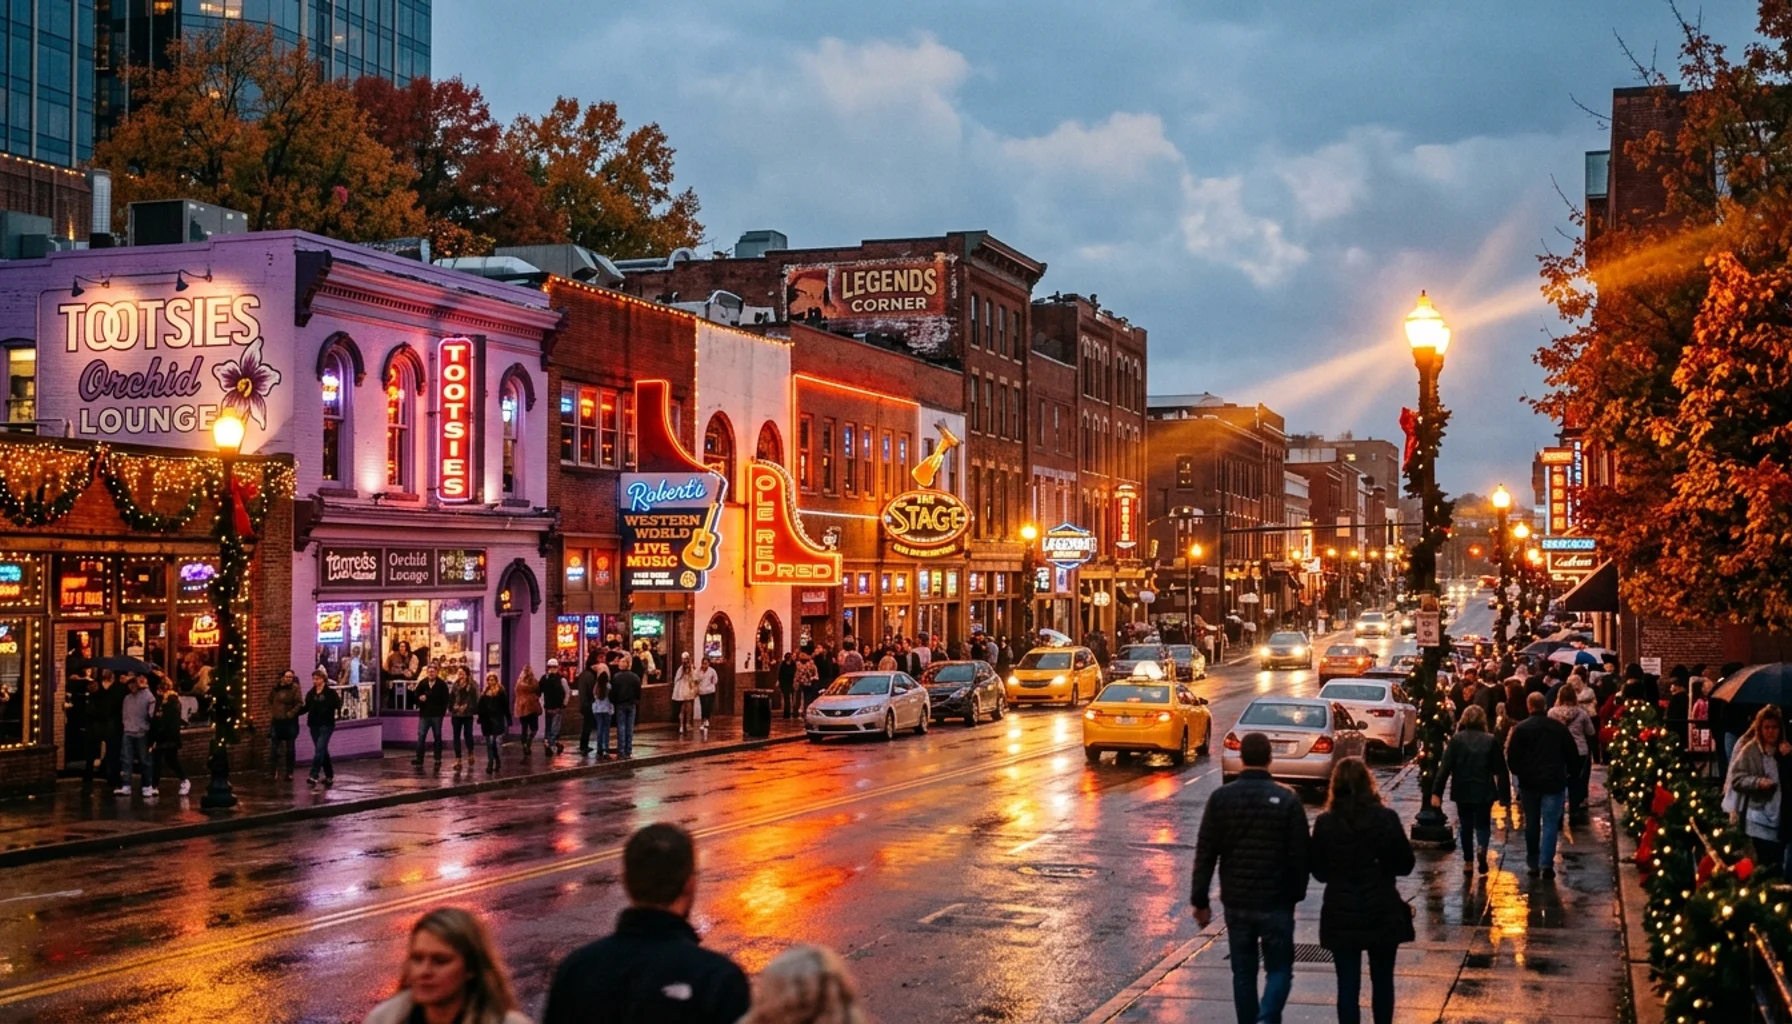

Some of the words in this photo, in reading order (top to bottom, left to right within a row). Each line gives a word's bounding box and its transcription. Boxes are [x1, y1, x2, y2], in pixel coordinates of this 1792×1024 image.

[842, 268, 937, 299] LEGENDS
[851, 297, 927, 312] CORNER
[58, 294, 261, 352] TOOTSIES
[78, 356, 204, 401] Orchid
[79, 404, 217, 434] LOUNGE
[443, 345, 466, 495] TOOTSIES
[755, 474, 777, 521] OLE
[623, 514, 701, 526] WESTERN
[888, 502, 962, 534] STAGE
[626, 555, 678, 567] MUSIC
[633, 542, 671, 555] LIVE
[755, 529, 776, 575] RED
